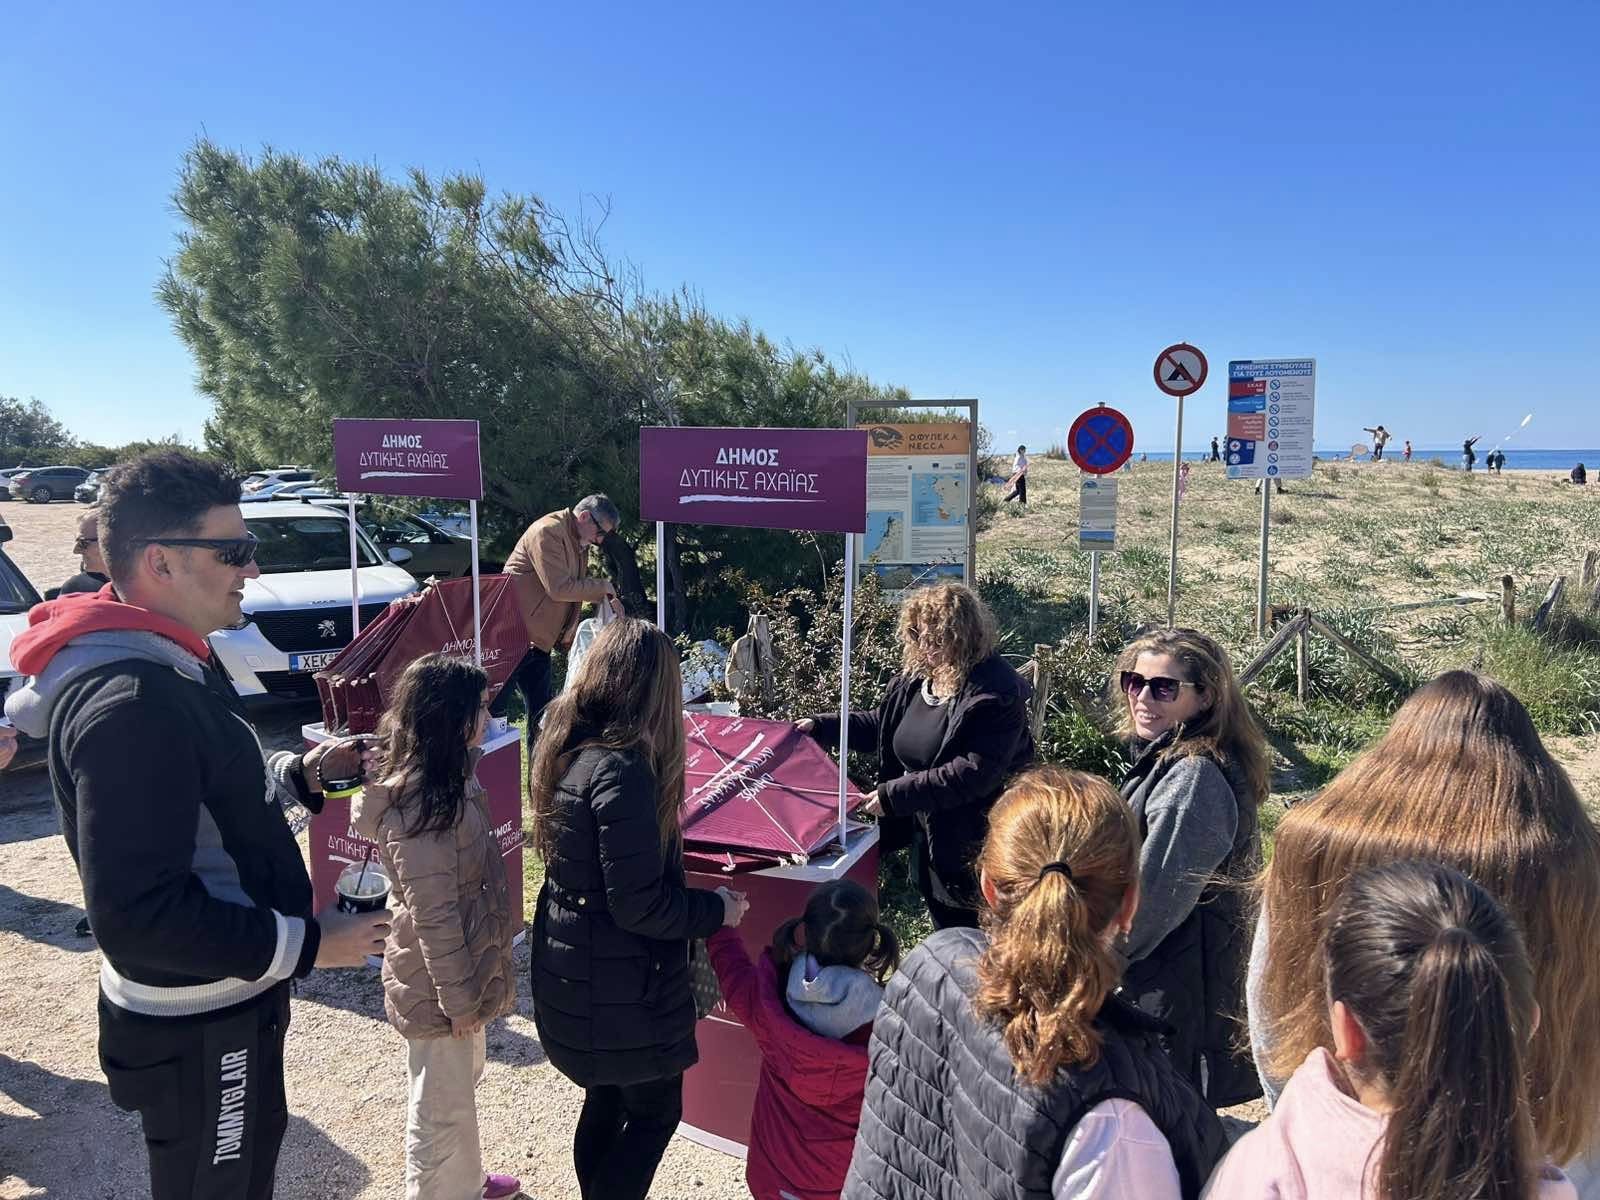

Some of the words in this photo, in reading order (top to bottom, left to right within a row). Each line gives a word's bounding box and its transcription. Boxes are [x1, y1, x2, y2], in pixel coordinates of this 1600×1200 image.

[382, 433, 423, 449] ΔΗΜΟΣ
[359, 452, 405, 468] ΔΥΤΙΚΗΣ
[407, 450, 449, 470] ΑΧΑΪΑΣ
[715, 447, 779, 466] ΔΗΜΟΣ
[679, 468, 749, 490] ΔΥΤΙΚΗΣ
[754, 469, 819, 493] ΑΧΑΪΑΣ
[328, 835, 368, 860] ΔΥΤΙΚΗΣ
[213, 1048, 248, 1165] TOMMYGLAIR
